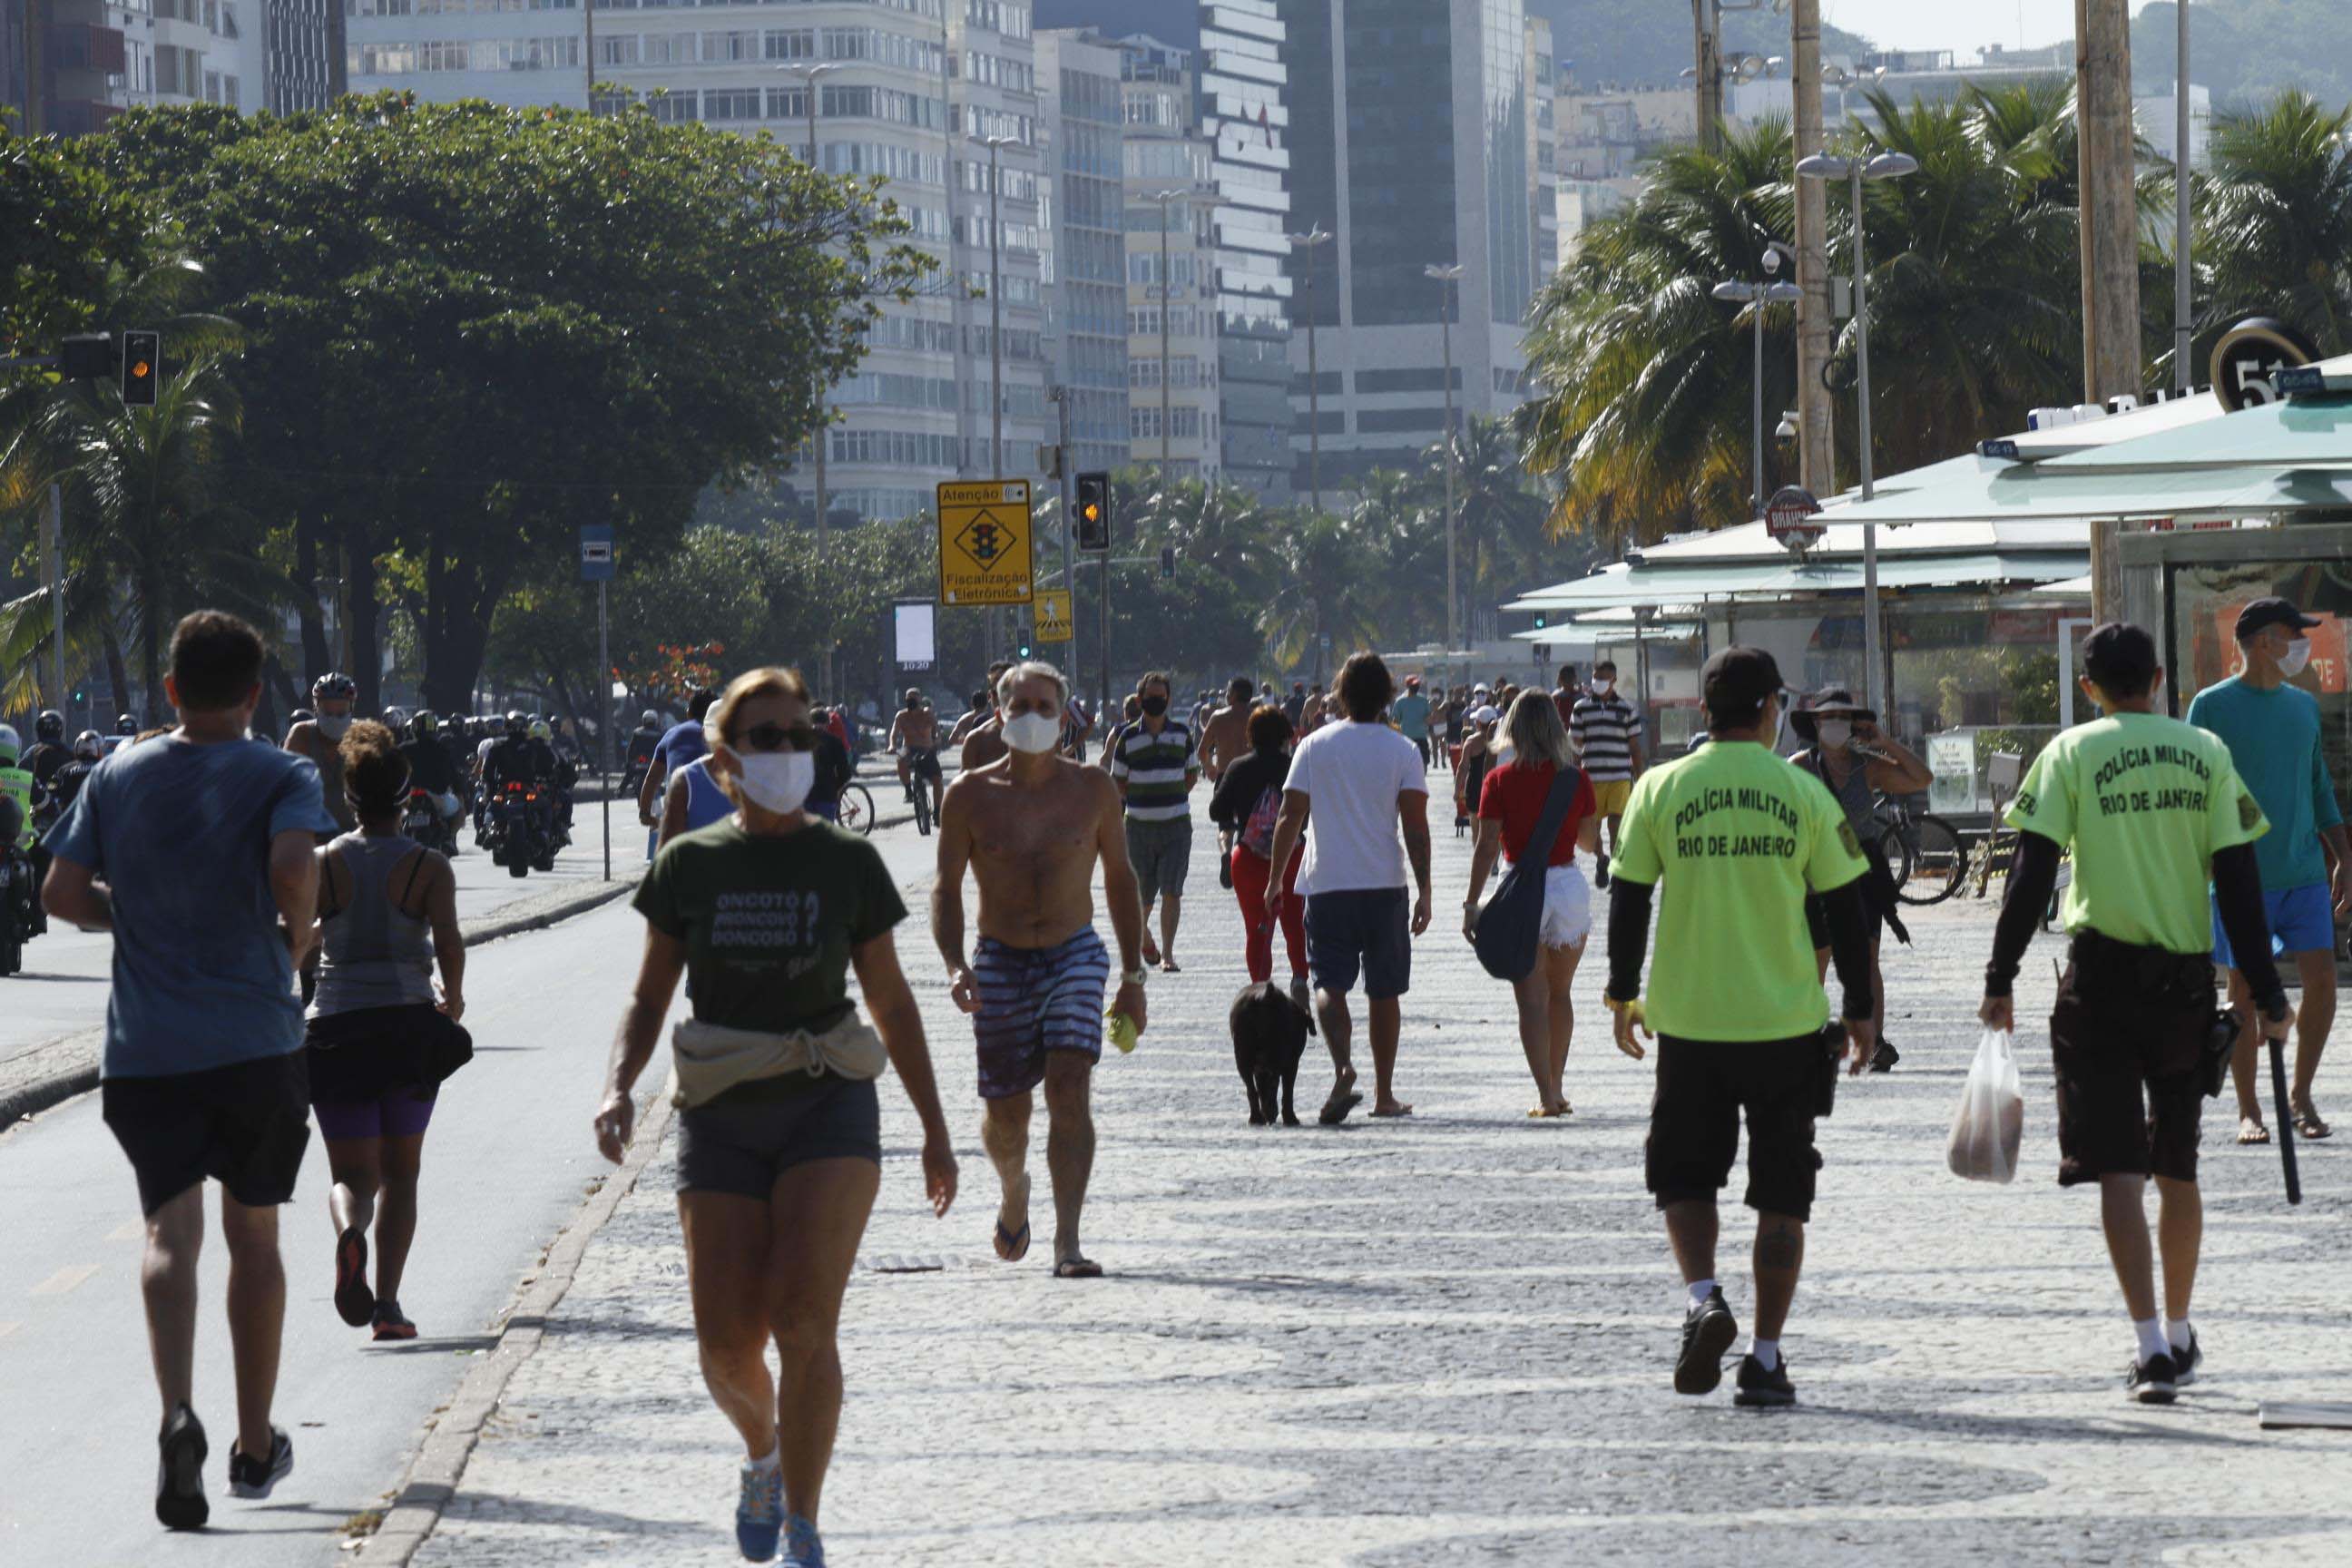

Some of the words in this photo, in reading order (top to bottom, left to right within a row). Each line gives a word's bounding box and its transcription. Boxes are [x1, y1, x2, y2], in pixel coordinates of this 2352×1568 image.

[944, 488, 999, 502] Atenção
[1771, 510, 1812, 529] BRAHM
[946, 573, 1027, 588] Fiscalização
[955, 584, 1020, 600] Eletrônica
[2094, 747, 2151, 794] POLÍCIA
[1675, 788, 1733, 836] POLÍCIA
[1739, 788, 1798, 836] MILITAR
[2099, 795, 2127, 817] RIO
[2130, 792, 2151, 812] DE
[1678, 838, 1703, 858] RIO
[1708, 836, 1727, 856] DE
[1731, 836, 1797, 858] JANEIRO
